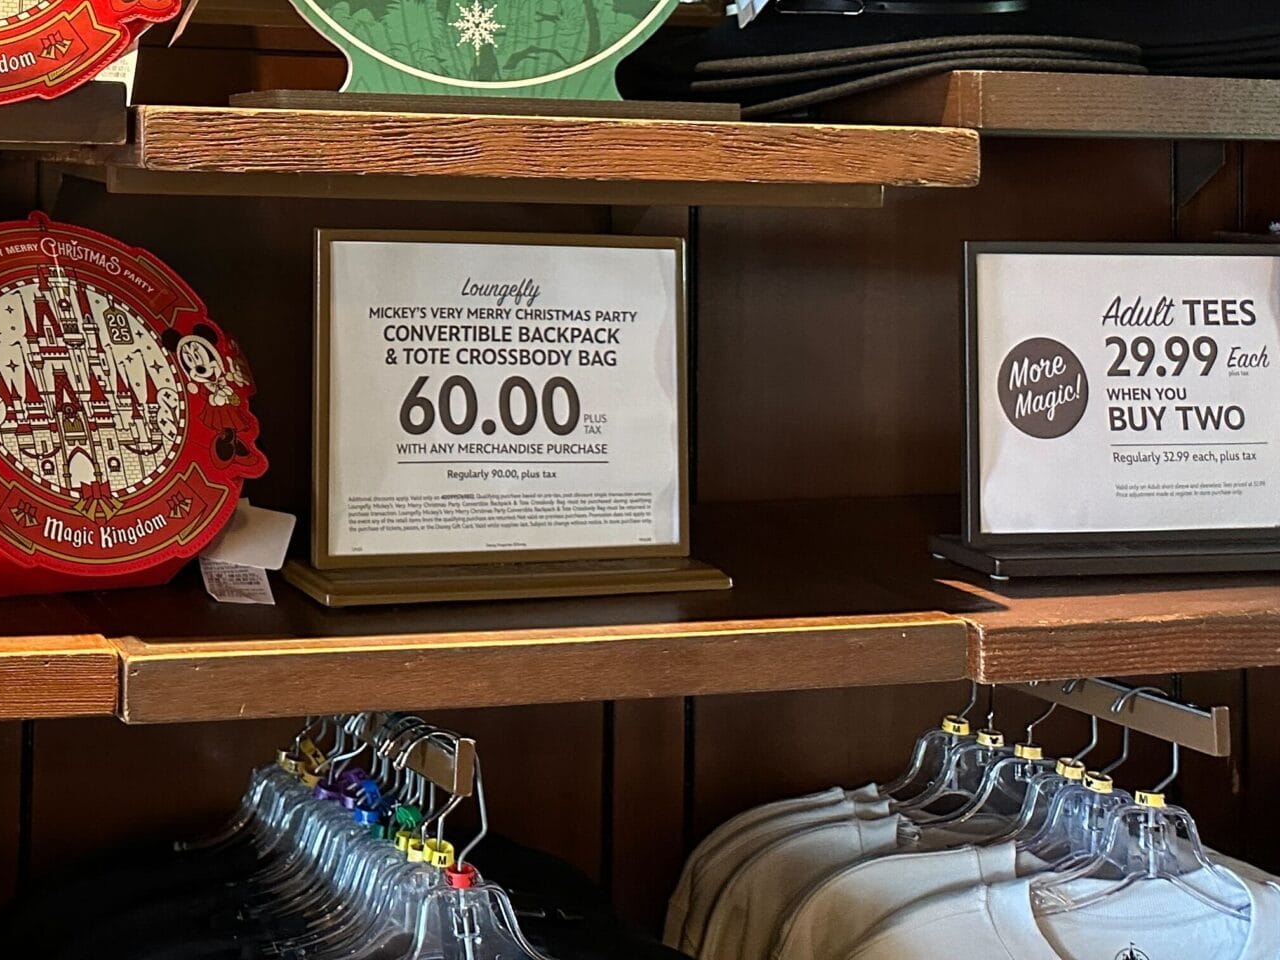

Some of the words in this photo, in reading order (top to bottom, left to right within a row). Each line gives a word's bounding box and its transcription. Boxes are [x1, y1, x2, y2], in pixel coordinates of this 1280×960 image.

[5, 243, 38, 255] MERRY
[40, 237, 121, 275] CHRISTMAS
[123, 269, 155, 294] PARTY
[461, 277, 541, 307] Loungefly
[369, 307, 427, 319] MICKEY'S
[430, 307, 464, 320] VERY
[467, 308, 512, 320] MERRY
[515, 309, 591, 322] CHRISTMAS
[595, 310, 638, 322] PARTY
[1102, 295, 1175, 327] Adult
[1182, 299, 1256, 326] TEES
[107, 314, 126, 327] 20
[111, 329, 130, 341] 25
[383, 325, 512, 343] CONVERTIBLE
[518, 326, 620, 344] BACKPACK
[385, 348, 398, 365] &
[403, 348, 450, 365] TOTE
[455, 348, 571, 366] CROSSBODY
[578, 350, 618, 367] BAG
[1105, 336, 1219, 378] 29.99
[1226, 345, 1270, 369] Each
[1008, 355, 1067, 391] More
[1014, 373, 1081, 422] Magic!
[1106, 387, 1152, 401] WHEN
[1154, 387, 1187, 401] YOU
[399, 374, 581, 436] 60.00
[583, 414, 607, 424] PLUS
[1108, 406, 1165, 432] BUY
[1176, 406, 1245, 431] TWO
[584, 425, 602, 435] TAX
[396, 443, 427, 454] WITH
[429, 443, 455, 454] ANY
[458, 443, 543, 454] MERCHANDISE
[547, 443, 608, 454] PURCHASE
[1112, 452, 1160, 466] Regularly
[1163, 451, 1190, 462] 32.99
[1192, 452, 1218, 463] each,
[1220, 451, 1240, 463] plus
[1242, 451, 1257, 461] tax
[447, 469, 489, 481] Regularly
[521, 469, 541, 480] plus
[542, 470, 557, 479] tax
[43, 516, 94, 548] Magic
[100, 513, 167, 548] Kingdom
[1138, 794, 1149, 804] M
[437, 855, 447, 865] M
